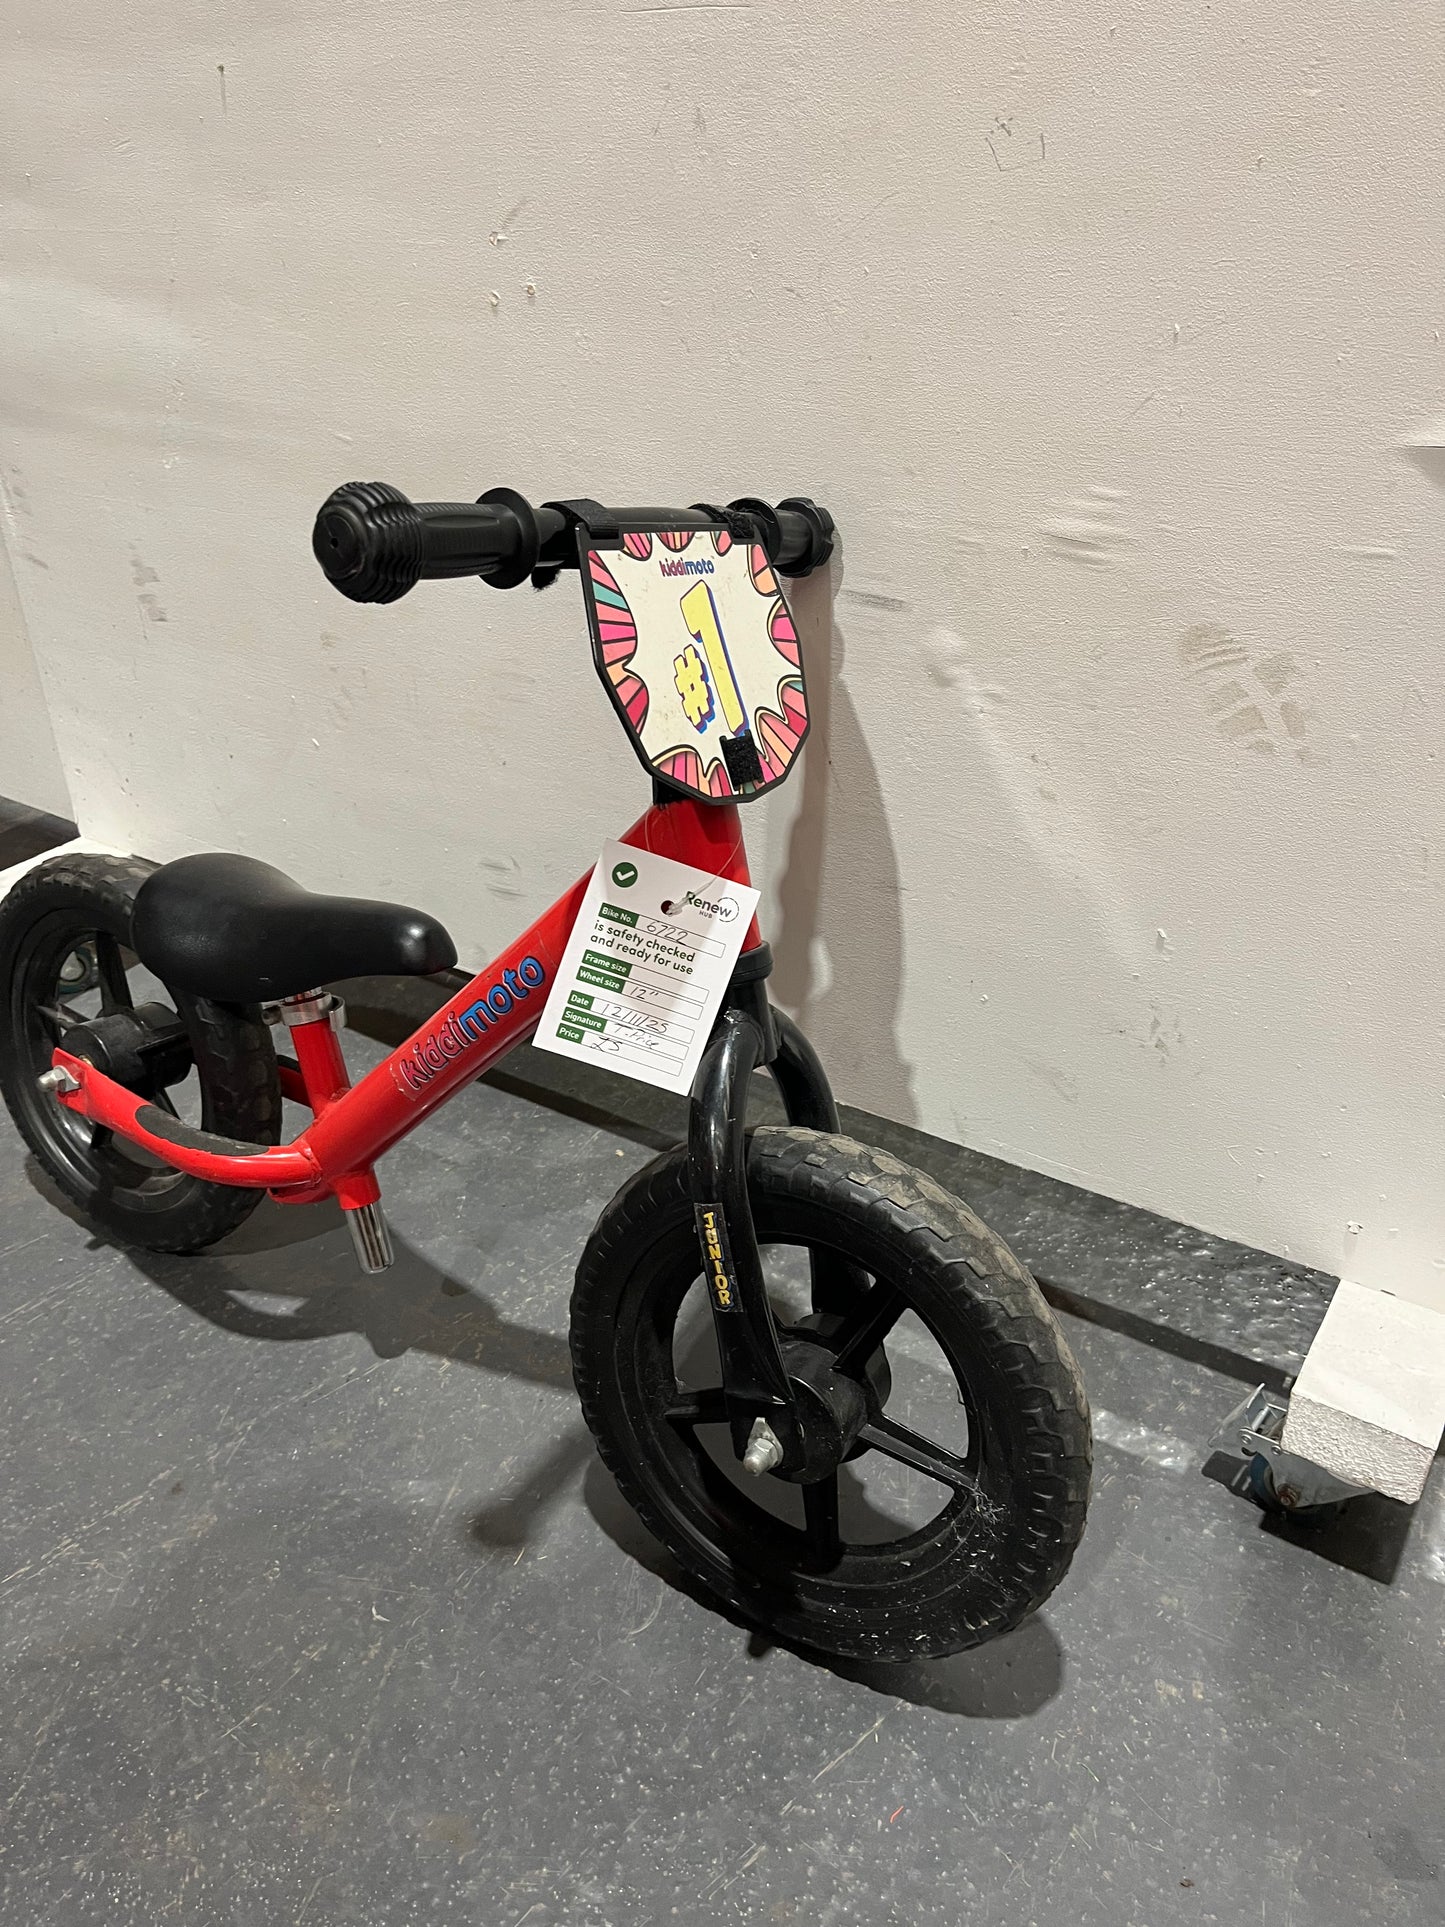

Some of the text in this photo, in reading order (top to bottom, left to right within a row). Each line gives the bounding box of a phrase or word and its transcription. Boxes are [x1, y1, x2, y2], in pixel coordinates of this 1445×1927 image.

[659, 557, 715, 577] kiddimoto
[673, 579, 750, 738] #1
[686, 890, 731, 918] Renew
[601, 906, 633, 924] Bike No.
[699, 910, 713, 919] HUB
[594, 919, 696, 962] is safety checked
[646, 921, 689, 945] 6722
[585, 953, 627, 973] Frame size
[590, 933, 694, 975] and ready for use
[579, 969, 620, 989] Wheel size
[570, 994, 590, 1006] Date
[400, 955, 545, 1090] kiddimoto
[564, 1010, 602, 1028] Signature
[558, 1027, 580, 1040] Price
[703, 1211, 732, 1305] JUNIOR
